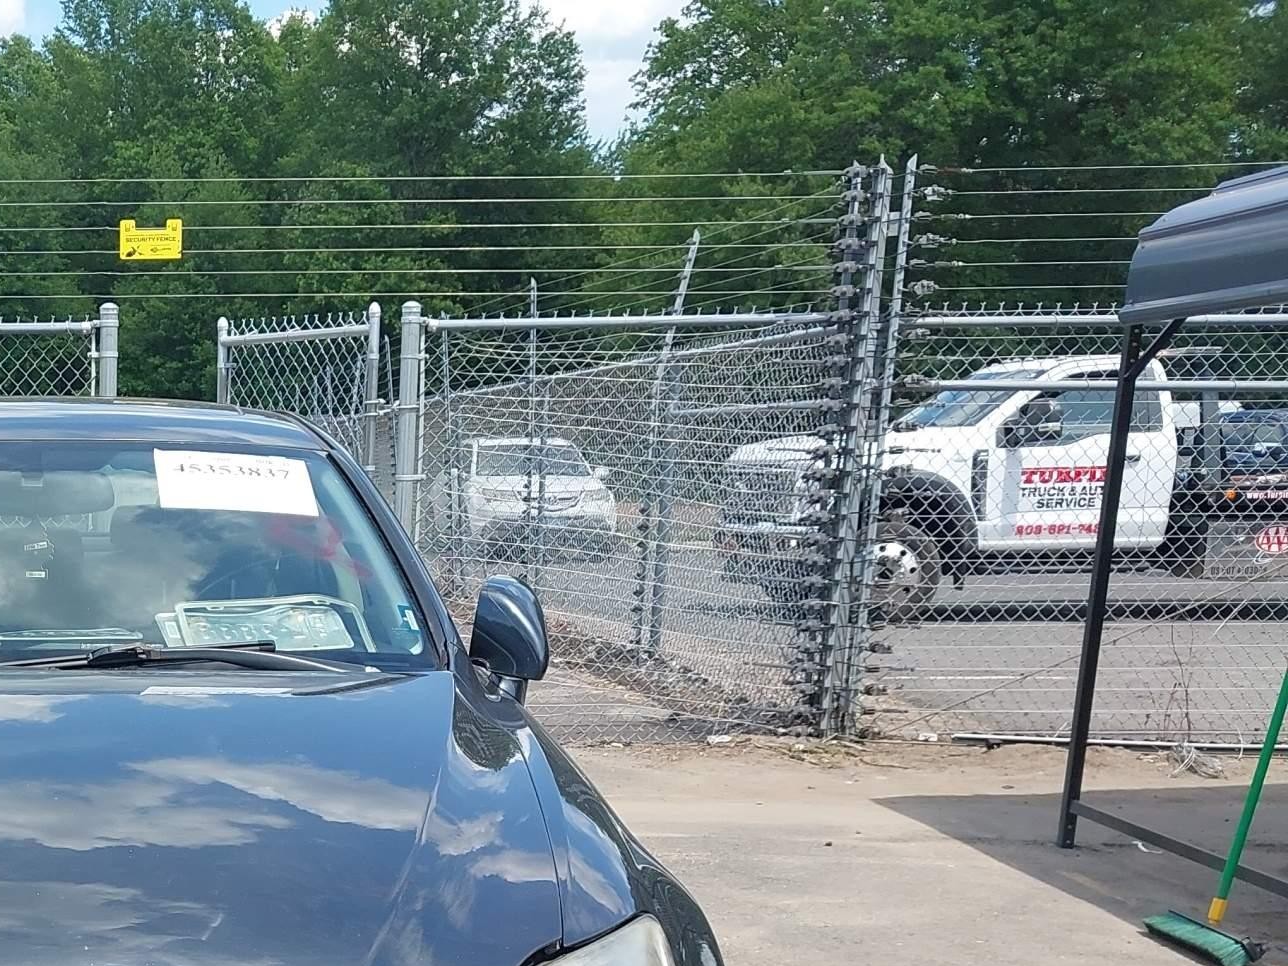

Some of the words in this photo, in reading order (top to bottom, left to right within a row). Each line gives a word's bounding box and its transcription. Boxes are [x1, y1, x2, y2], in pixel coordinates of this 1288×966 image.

[1021, 486, 1066, 498] TRUCK
[1068, 485, 1077, 497] &
[1036, 497, 1096, 509] SERVICE
